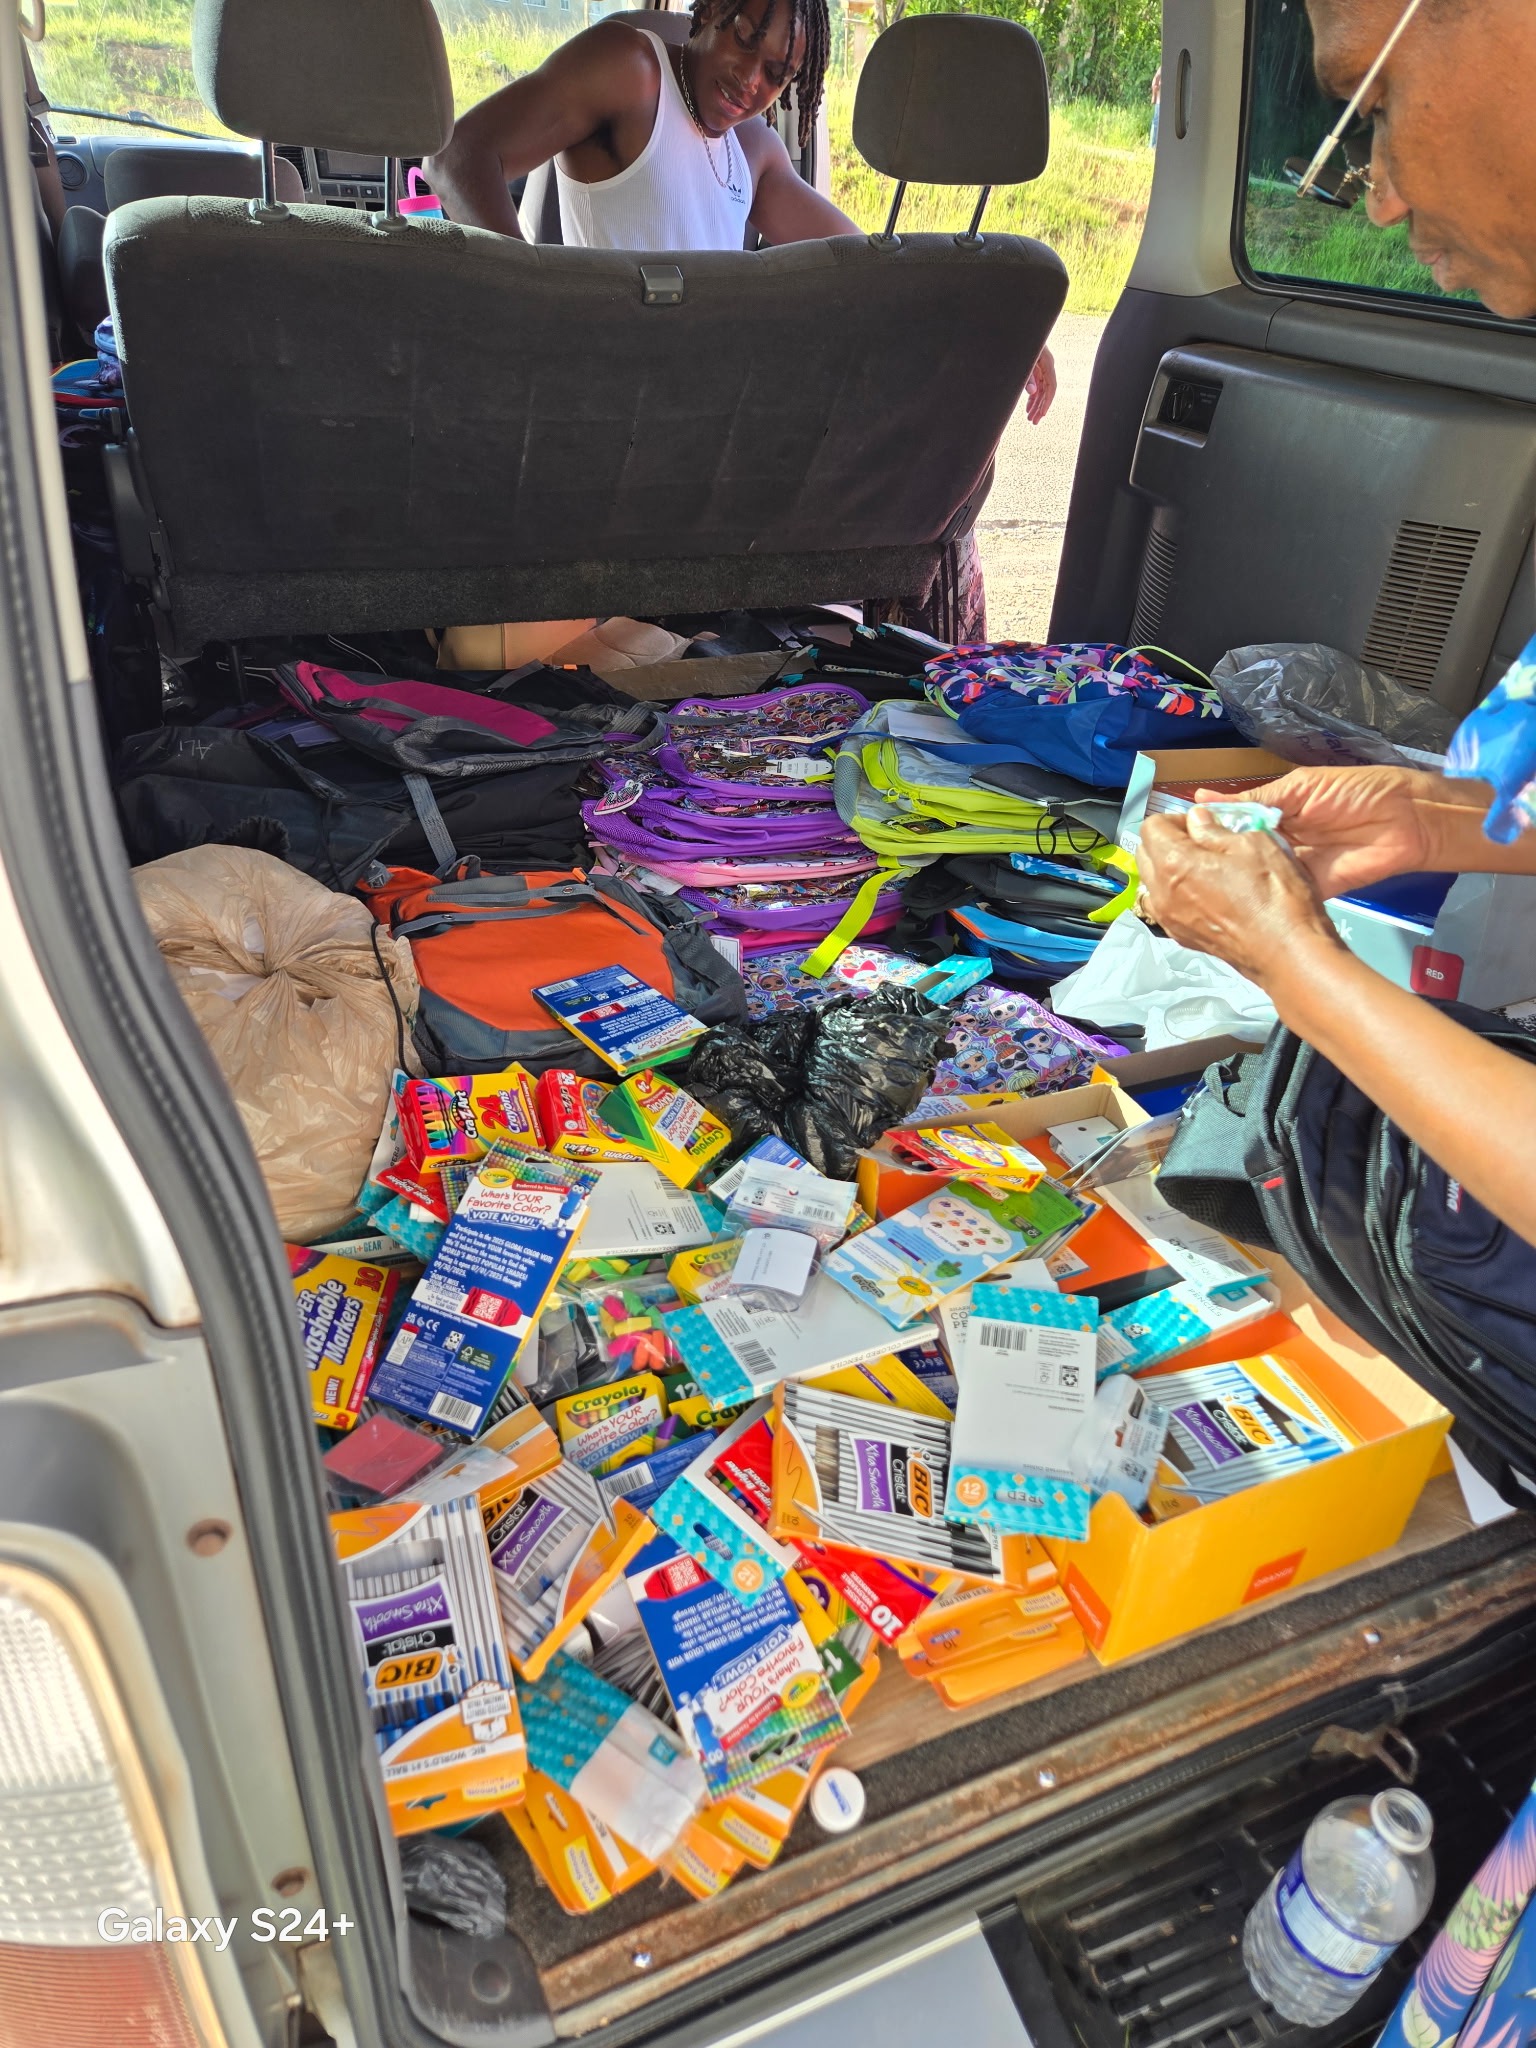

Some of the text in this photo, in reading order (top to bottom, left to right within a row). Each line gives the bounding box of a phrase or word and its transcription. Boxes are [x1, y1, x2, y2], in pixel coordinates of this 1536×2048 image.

[1425, 968, 1444, 980] RED
[477, 1095, 508, 1129] 24
[499, 1090, 520, 1134] Crayons
[646, 1093, 674, 1114] CRAYONS
[690, 1129, 725, 1157] Crayola
[467, 1199, 550, 1213] Favorite Color?
[481, 1189, 542, 1203] What's YOUR
[472, 1210, 535, 1224] VOTE NOW!
[352, 1263, 385, 1293] 10
[294, 1275, 344, 1370] Washable
[324, 1295, 360, 1363] Markers
[322, 1377, 341, 1405] NEW!
[570, 1383, 641, 1412] Crayola
[673, 1379, 701, 1401] 12
[568, 1408, 658, 1461] Favorite Color?
[576, 1405, 642, 1446] What's YOUR
[1213, 1407, 1247, 1447] Cristal
[1233, 1405, 1270, 1445] BIC
[582, 1446, 609, 1465] VOTE
[862, 1439, 884, 1508] Xtra Smooth
[723, 1457, 775, 1509] uper Brighter
[743, 1465, 770, 1494] Colors!
[892, 1458, 906, 1499] Cristal
[912, 1465, 929, 1514] BIC
[962, 1482, 981, 1496] 12
[490, 1501, 527, 1541] Cristal
[497, 1501, 554, 1569] Xtra Smooth
[361, 1594, 444, 1633] Xtra Smooth
[842, 1584, 869, 1614] CLASSIC
[866, 1600, 904, 1639] 10
[385, 1629, 435, 1653] Cristal
[716, 1629, 787, 1685] VOTE NOW!
[376, 1655, 438, 1684] BIC
[715, 1637, 804, 1712] Favorite Color?
[733, 1656, 801, 1713] What's YOUR
